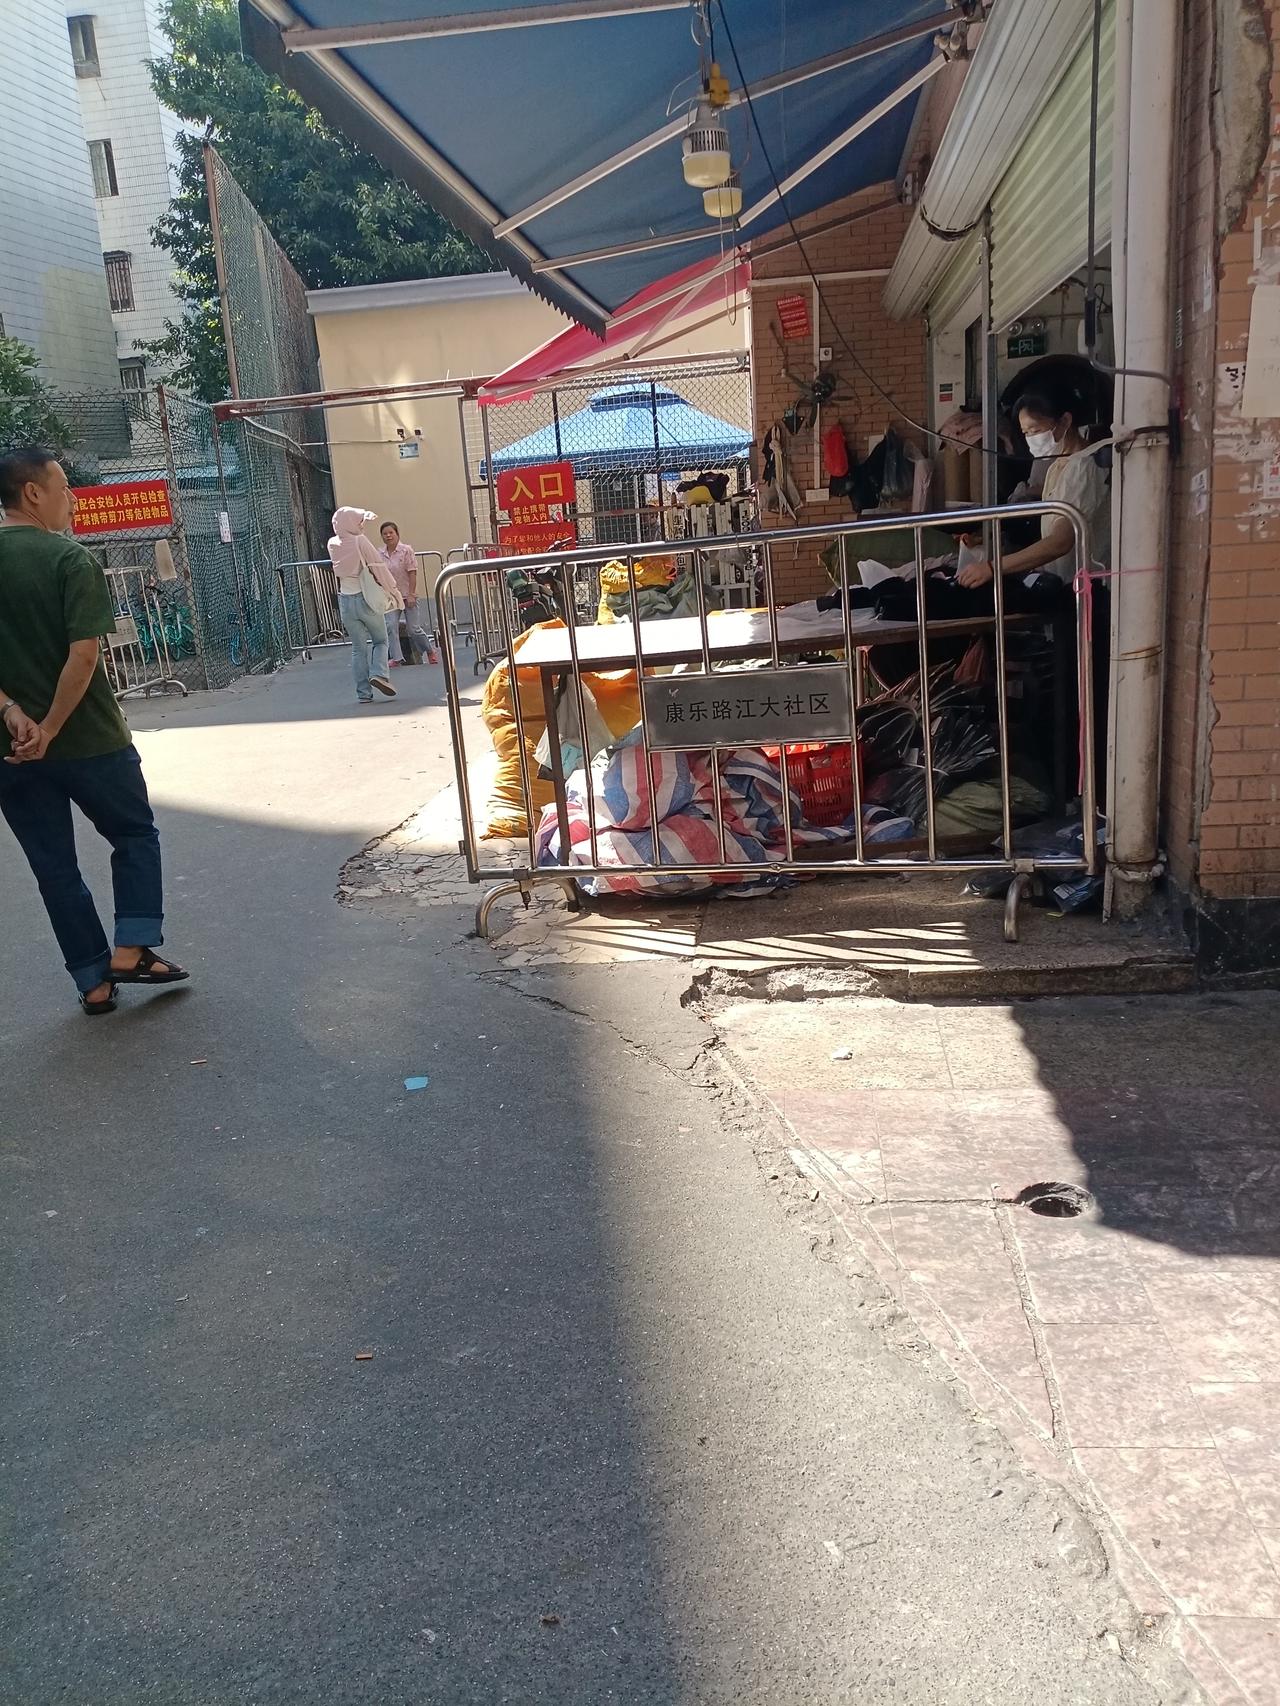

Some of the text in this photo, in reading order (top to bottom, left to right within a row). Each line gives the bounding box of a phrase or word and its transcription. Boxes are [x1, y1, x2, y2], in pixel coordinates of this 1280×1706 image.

[510, 473, 564, 502] 入口
[513, 503, 546, 515] 禁止携带
[514, 513, 547, 525] 宠物入内
[665, 692, 831, 724] 康乐路江大社区
